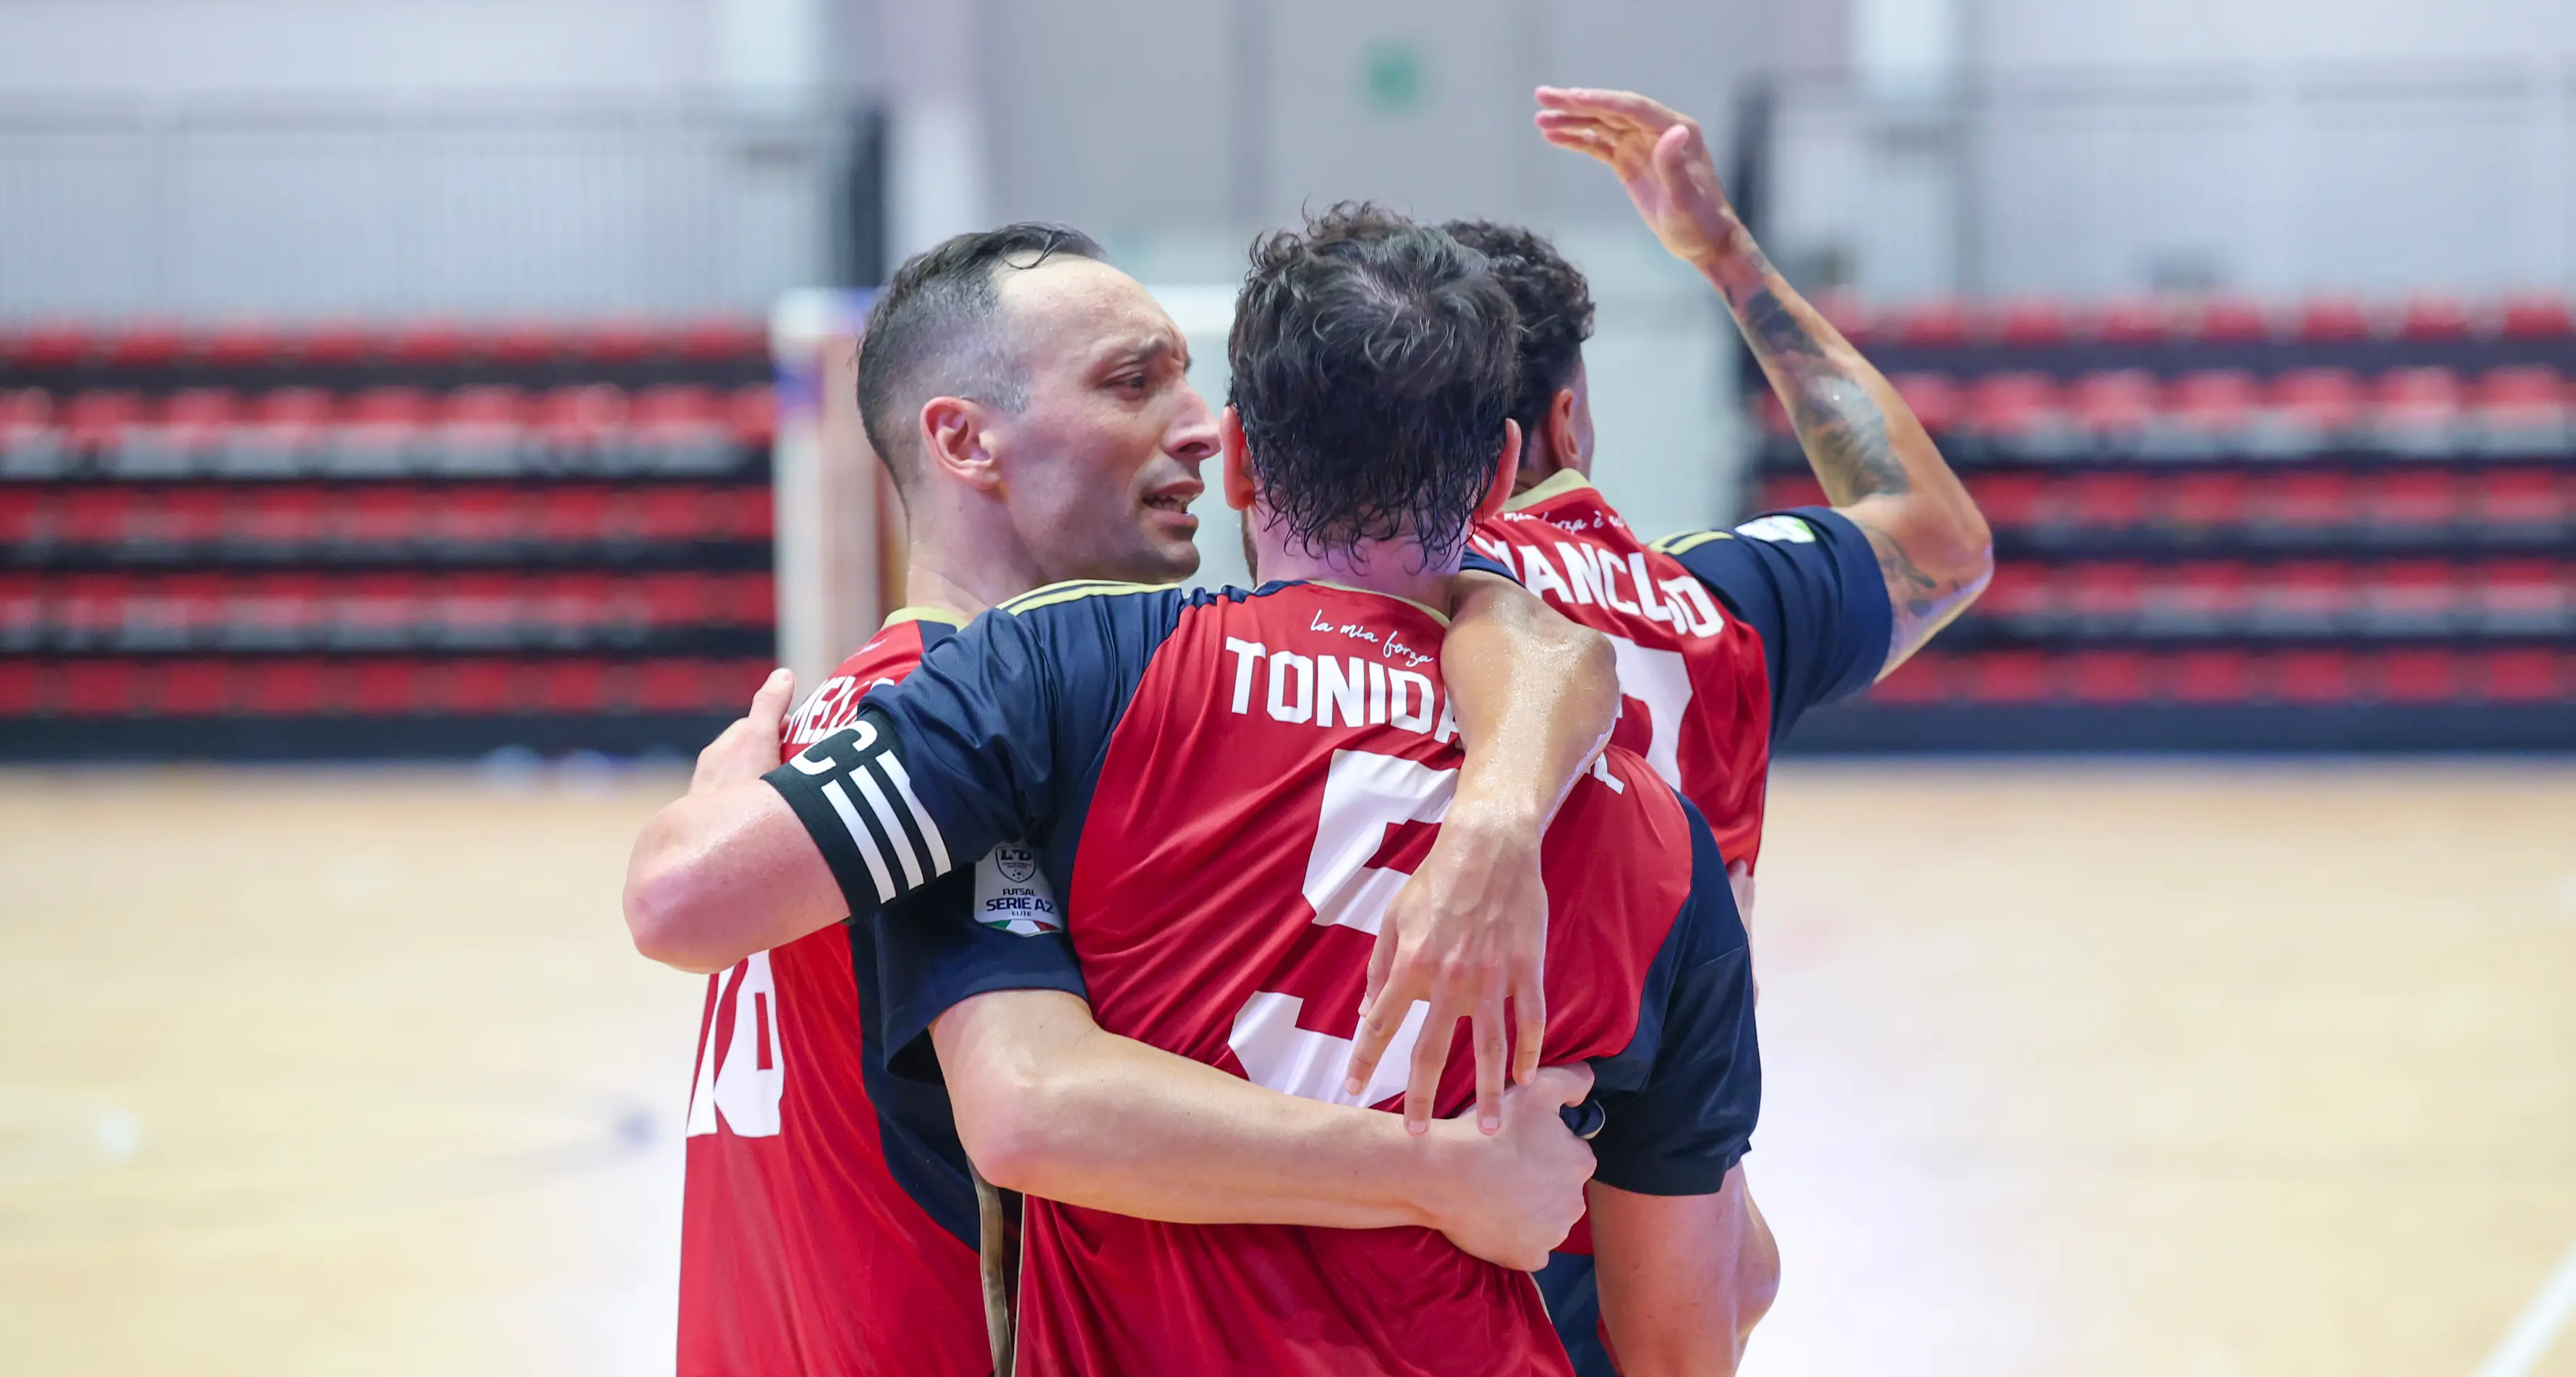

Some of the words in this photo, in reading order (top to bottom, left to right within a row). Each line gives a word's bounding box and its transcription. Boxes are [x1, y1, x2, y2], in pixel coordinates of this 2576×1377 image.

[1310, 608, 1334, 633] la
[1339, 622, 1379, 644] mia
[1382, 630, 1434, 668] forza
[789, 720, 878, 776] C
[986, 897, 1032, 912] SERIE
[1034, 898, 1056, 914] A2
[1002, 887, 1036, 897] FUTSAL
[1227, 748, 1459, 1109] 5
